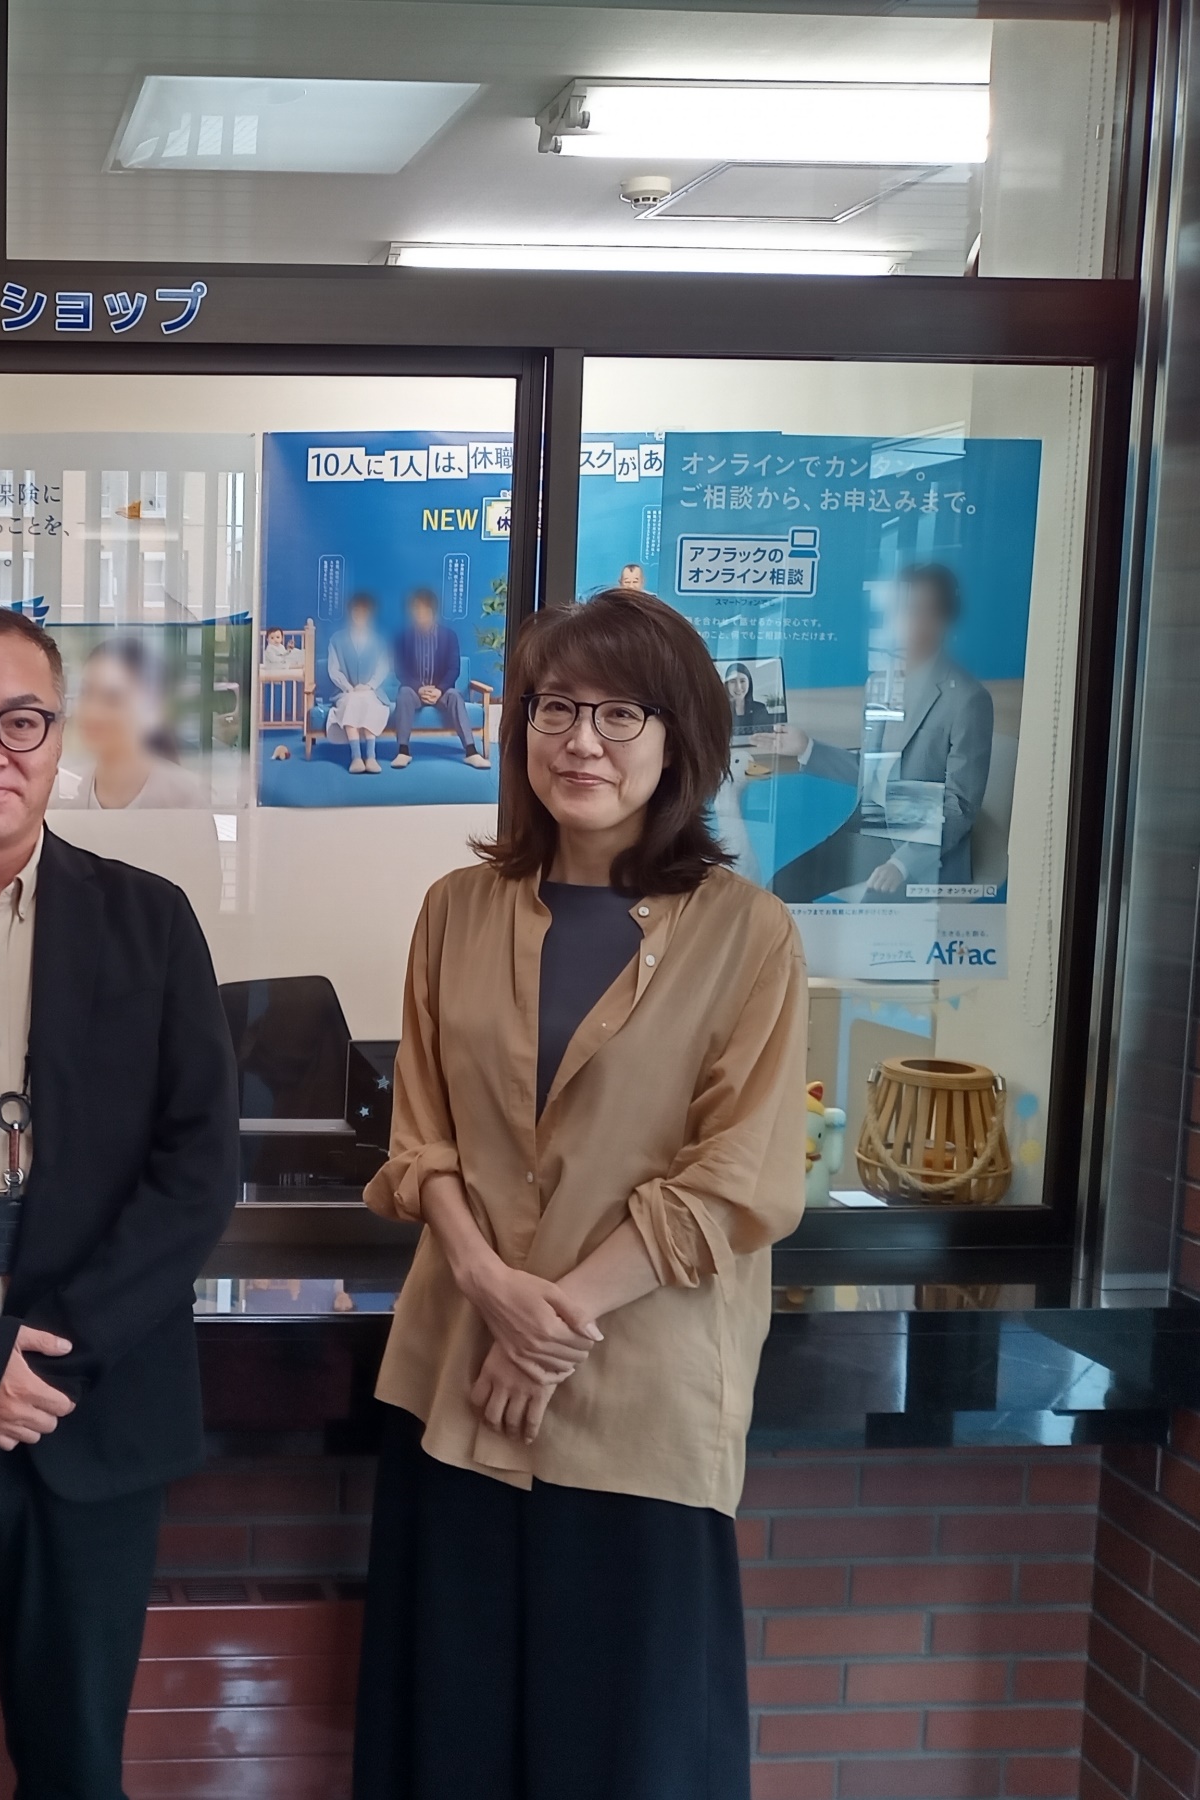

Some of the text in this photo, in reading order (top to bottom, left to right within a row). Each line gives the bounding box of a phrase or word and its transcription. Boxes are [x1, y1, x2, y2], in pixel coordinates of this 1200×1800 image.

[681, 451, 926, 482] オンラインでカンタン。
[679, 484, 977, 515] ご相談から、お申込みまで。
[422, 508, 479, 532] NEW
[689, 544, 784, 564] アフラックの
[688, 567, 805, 586] オンライン相談
[697, 630, 838, 642] のこと、何でもご相談いただけます。
